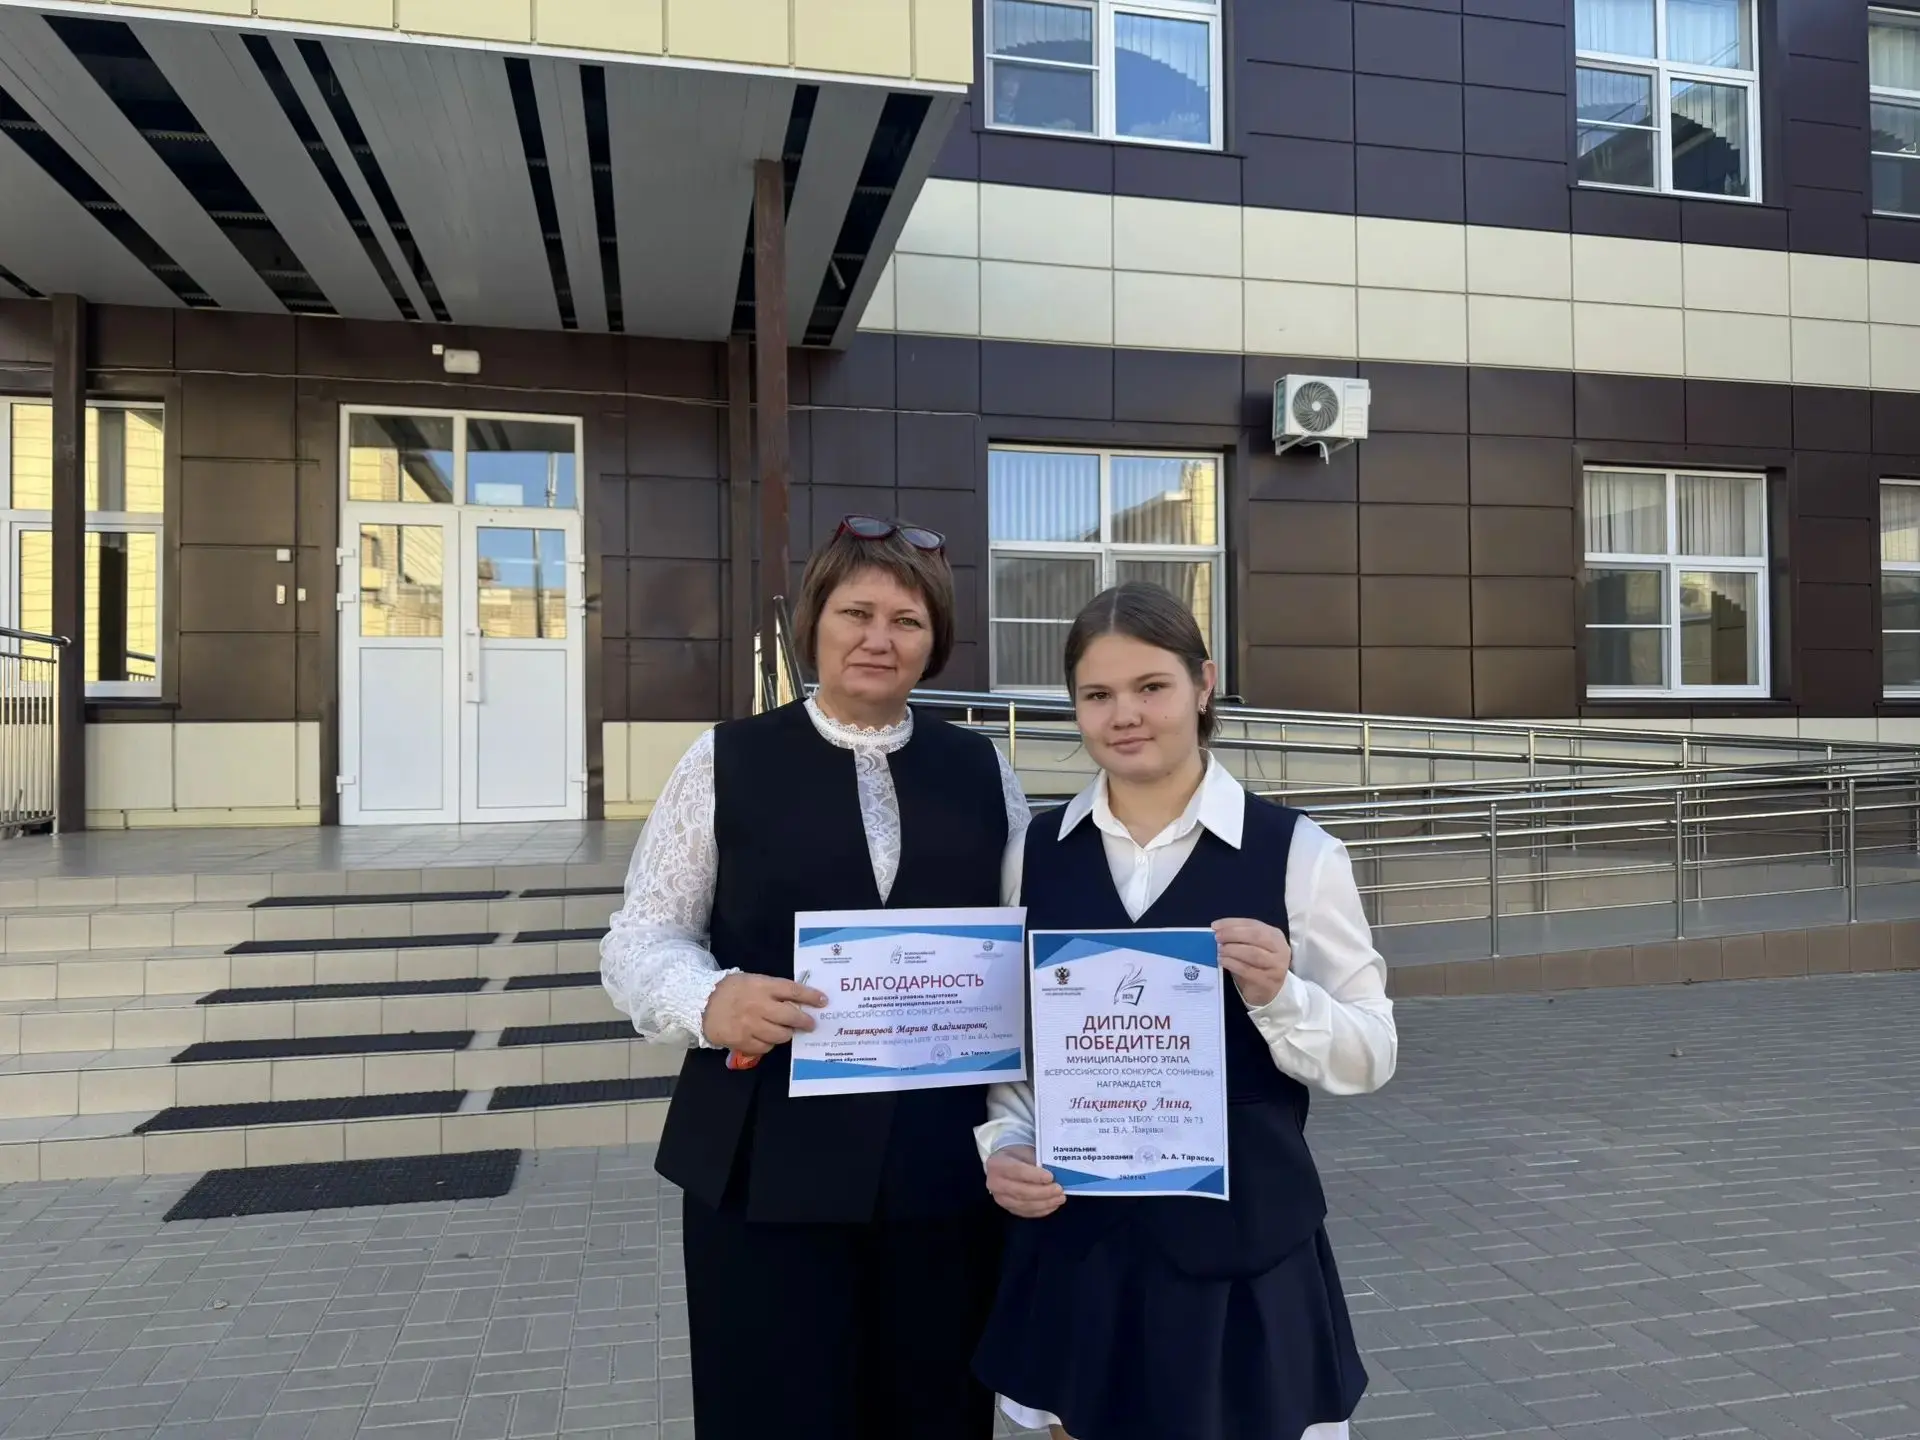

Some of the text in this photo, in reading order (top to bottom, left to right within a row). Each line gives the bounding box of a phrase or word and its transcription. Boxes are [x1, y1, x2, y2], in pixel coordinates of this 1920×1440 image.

[841, 974, 984, 993] БЛАГОДАРНОСТЬ
[820, 1008, 904, 1020] ВСЕРОССИЙСКОГО
[907, 1006, 951, 1016] КОНКУРСА
[834, 1026, 893, 1036] Анищенковой
[896, 1024, 928, 1035] Марине
[1083, 1015, 1171, 1033] ДИПЛОМ
[1065, 1035, 1190, 1053] ПОБЕДИТЕЛЯ
[1066, 1055, 1190, 1064] МУНИЦИПАЛЬНОГО ЭТАПА
[1044, 1068, 1119, 1076] ВСЕРОССИЙСКОГО
[1166, 1068, 1214, 1076] СОЧИНЕНИЙ
[1070, 1097, 1192, 1112] Никитенко Анна,
[1128, 1115, 1153, 1123] МБОУ
[1082, 1154, 1134, 1162] образования
[1181, 1153, 1215, 1162] Тараско
